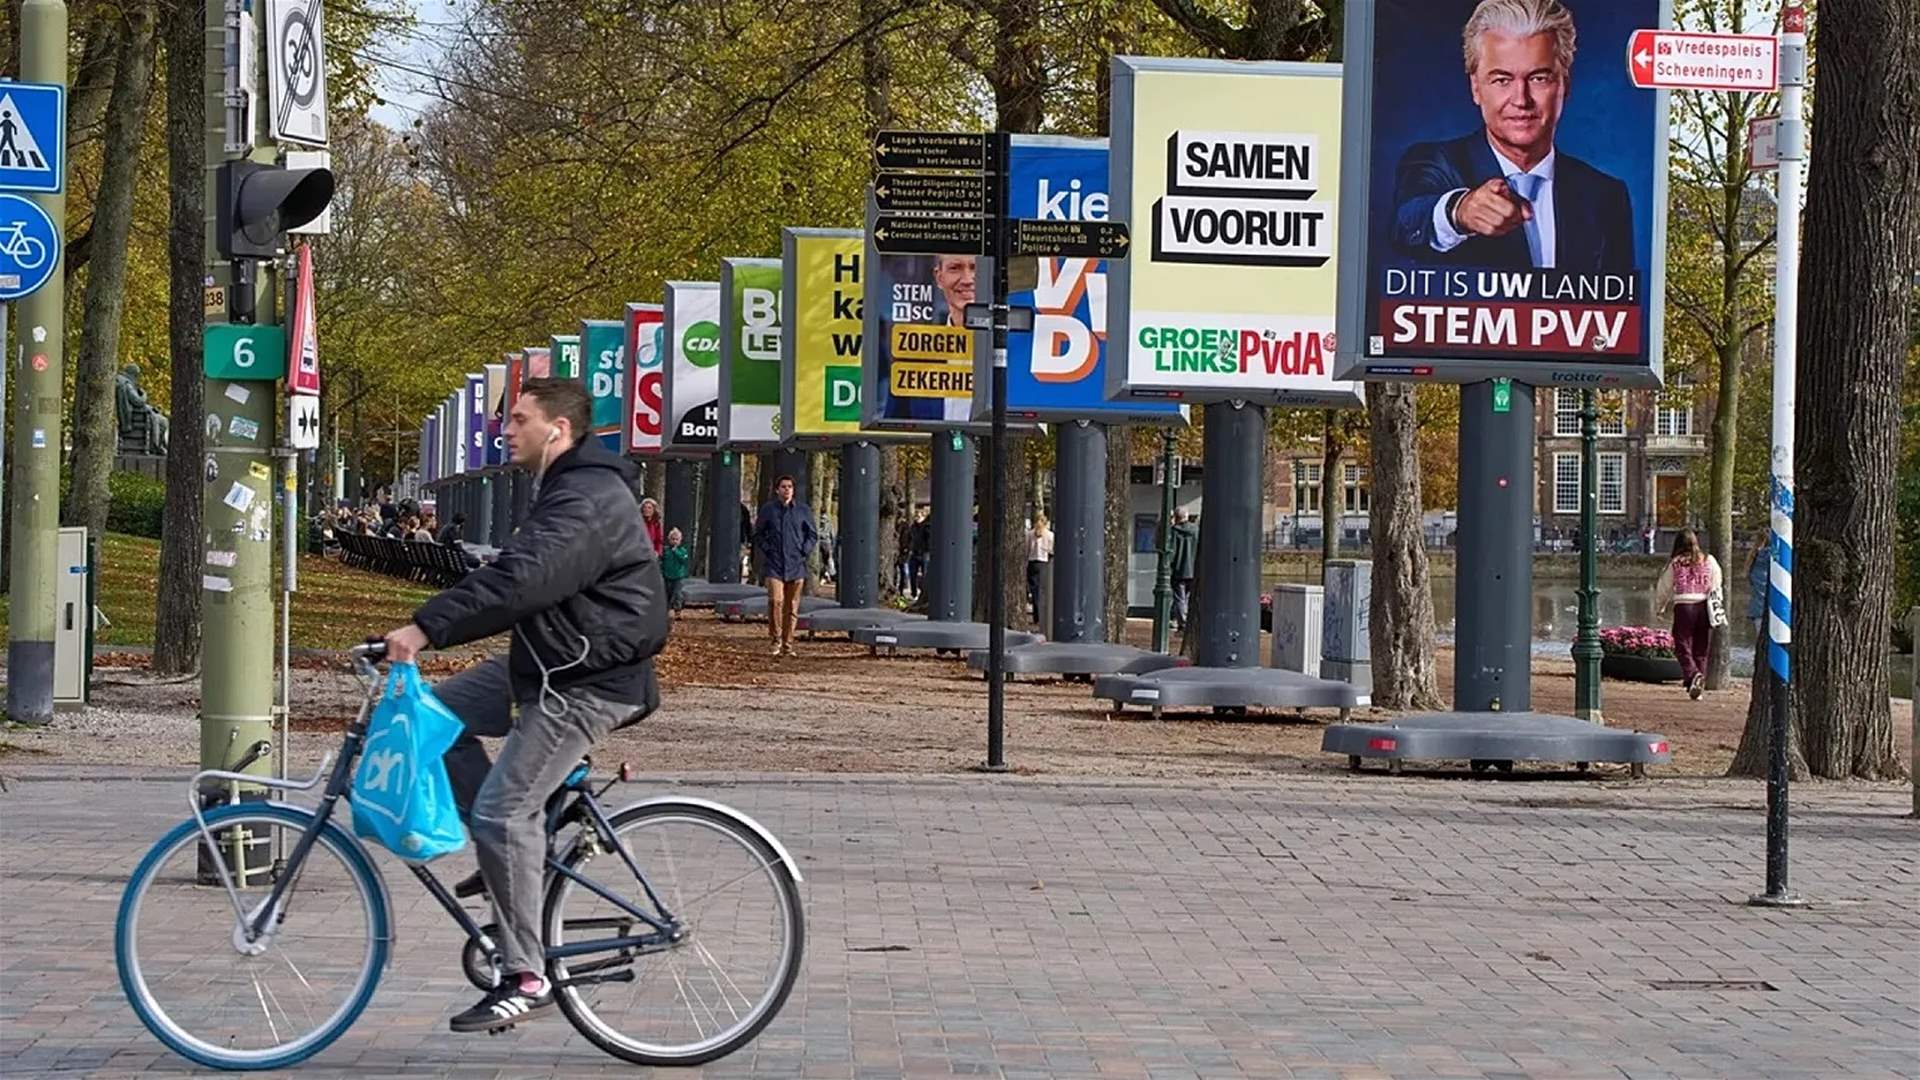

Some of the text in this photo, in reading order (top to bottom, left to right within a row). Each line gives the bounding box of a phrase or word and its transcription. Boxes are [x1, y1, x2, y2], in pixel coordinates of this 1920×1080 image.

[1676, 39, 1762, 58] Vredespaleis
[1657, 62, 1763, 82] Scheveningen 3
[891, 136, 916, 146] Lange
[919, 136, 956, 145] Voorhout
[1185, 141, 1310, 181] SAMEN
[891, 188, 925, 196] Theater
[927, 189, 954, 199] Pepijn
[1022, 223, 1068, 232] Binnenhof
[1022, 233, 1075, 243] Mauritshuis
[1170, 207, 1324, 248] VOORUIT
[1021, 243, 1051, 252] Politie
[834, 254, 859, 283] H
[892, 283, 932, 302] STEM
[1386, 269, 1635, 301] DIT IS UW LAND!
[1393, 305, 1518, 345] STEM
[1531, 309, 1627, 348] PVV
[898, 332, 967, 354] ZORGEN
[1139, 327, 1238, 350] GROEN
[233, 338, 256, 368] 6
[1155, 350, 1238, 374] LINKS
[1239, 330, 1325, 375] PvdA
[897, 369, 973, 392] ZEKERHE
